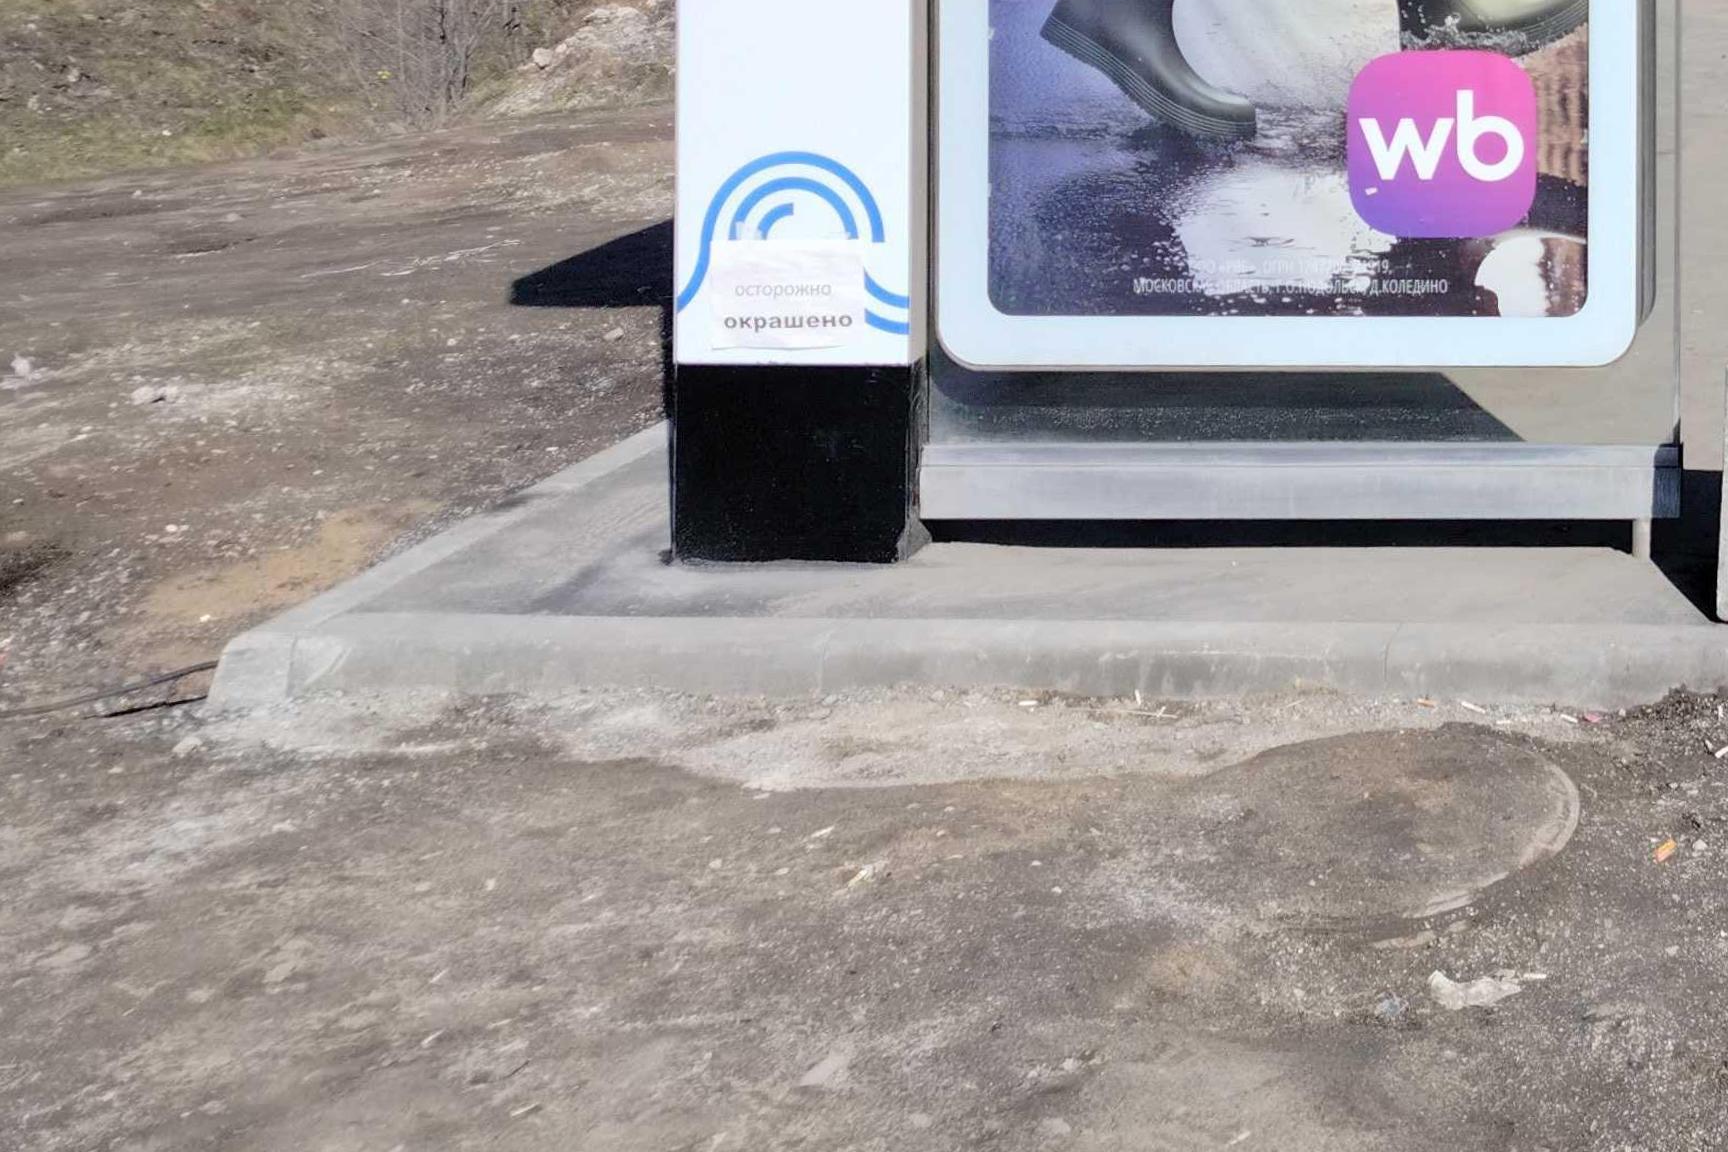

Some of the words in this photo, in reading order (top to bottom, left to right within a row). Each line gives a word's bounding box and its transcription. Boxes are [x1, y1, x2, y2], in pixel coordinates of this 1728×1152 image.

[1358, 89, 1524, 181] wb
[735, 283, 832, 300] осторожно
[724, 314, 853, 333] окрашено
